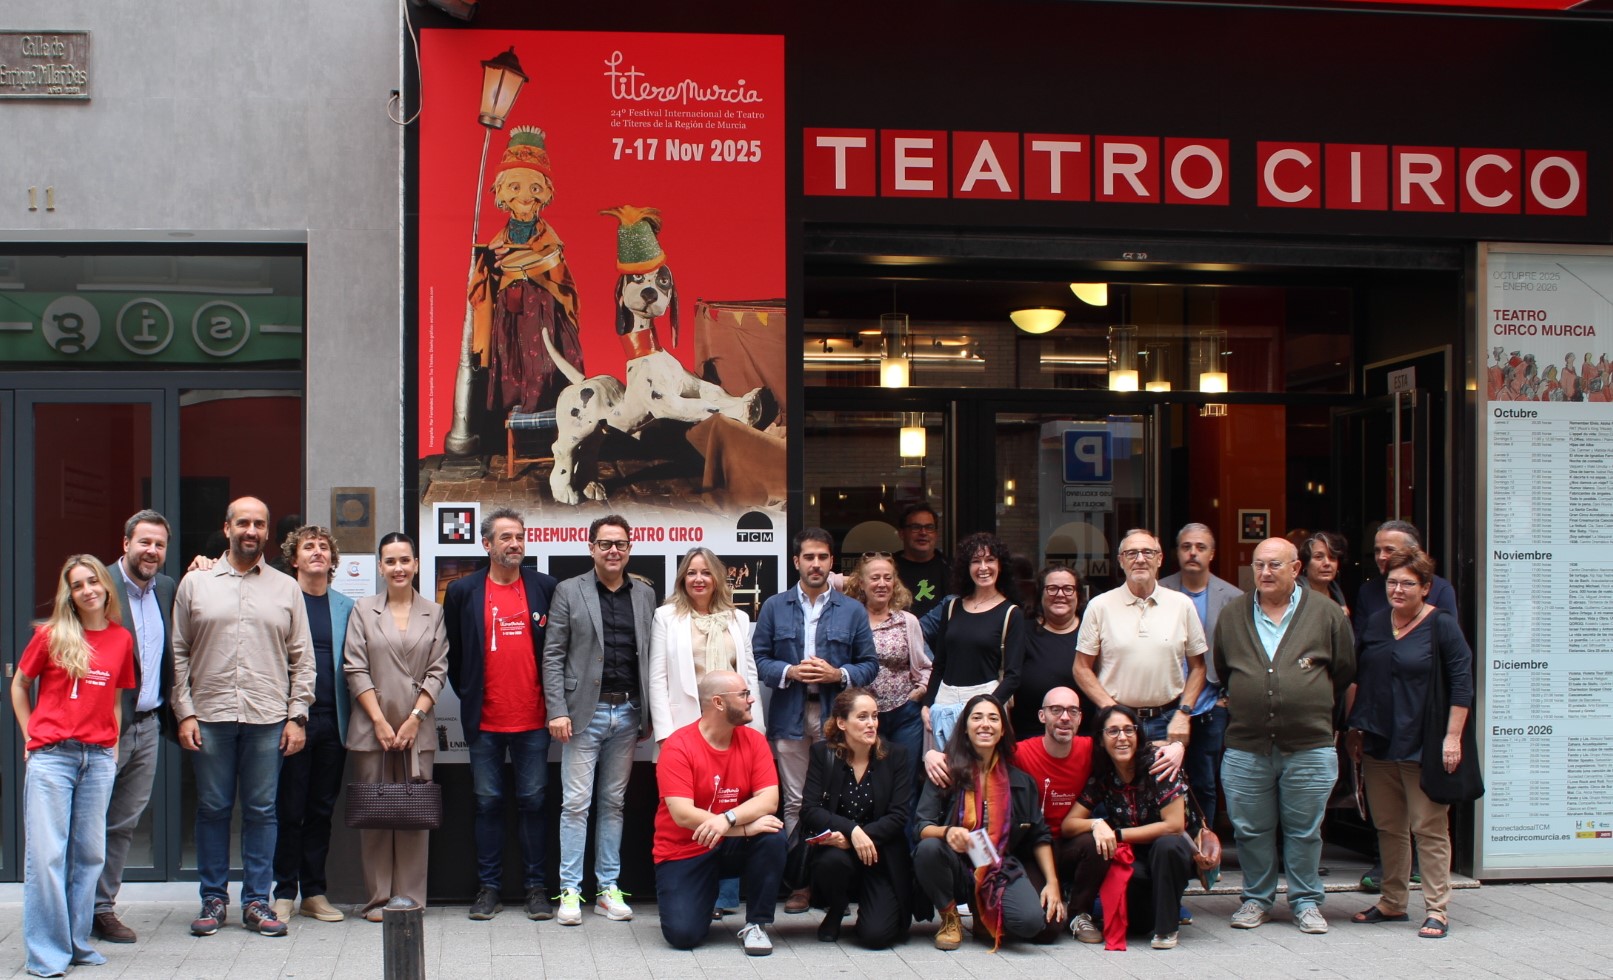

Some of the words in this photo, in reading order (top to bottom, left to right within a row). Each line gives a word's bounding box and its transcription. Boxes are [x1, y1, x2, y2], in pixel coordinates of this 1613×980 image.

[22, 35, 49, 56] Calle
[52, 35, 65, 56] de
[629, 108, 662, 117] Festival
[665, 108, 722, 118] Internacional
[724, 109, 735, 118] de
[737, 110, 765, 119] Teatro
[610, 118, 621, 127] de
[653, 118, 663, 128] de
[665, 118, 673, 128] la
[675, 119, 704, 131] Región
[705, 120, 716, 129] de
[717, 120, 747, 130] Murcia
[612, 137, 659, 161] 7-17
[666, 138, 704, 162] Nov
[711, 139, 762, 163] 2025
[815, 136, 1223, 199] TEATRO
[1262, 148, 1581, 209] CIRCO
[27, 185, 56, 211] 11
[1493, 271, 1537, 280] OCTUBRE
[1539, 272, 1561, 281] 2025
[1502, 282, 1535, 291] ENERO
[1536, 282, 1558, 292] 2026
[1493, 309, 1547, 321] TEATRO
[1493, 324, 1538, 335] CIRCO
[1541, 325, 1596, 336] MURCIA
[1494, 408, 1538, 418] Octubre
[524, 527, 588, 543] EREMURCI
[629, 527, 665, 542] EATRO
[668, 526, 704, 542] CIRCO
[738, 532, 773, 542] TCM
[1493, 550, 1552, 560] Noviembre
[1493, 659, 1549, 670] Diciembre
[1492, 726, 1524, 736] Enero
[1527, 725, 1553, 735] 2026
[1491, 833, 1571, 842] teatrocircomurcia.es
